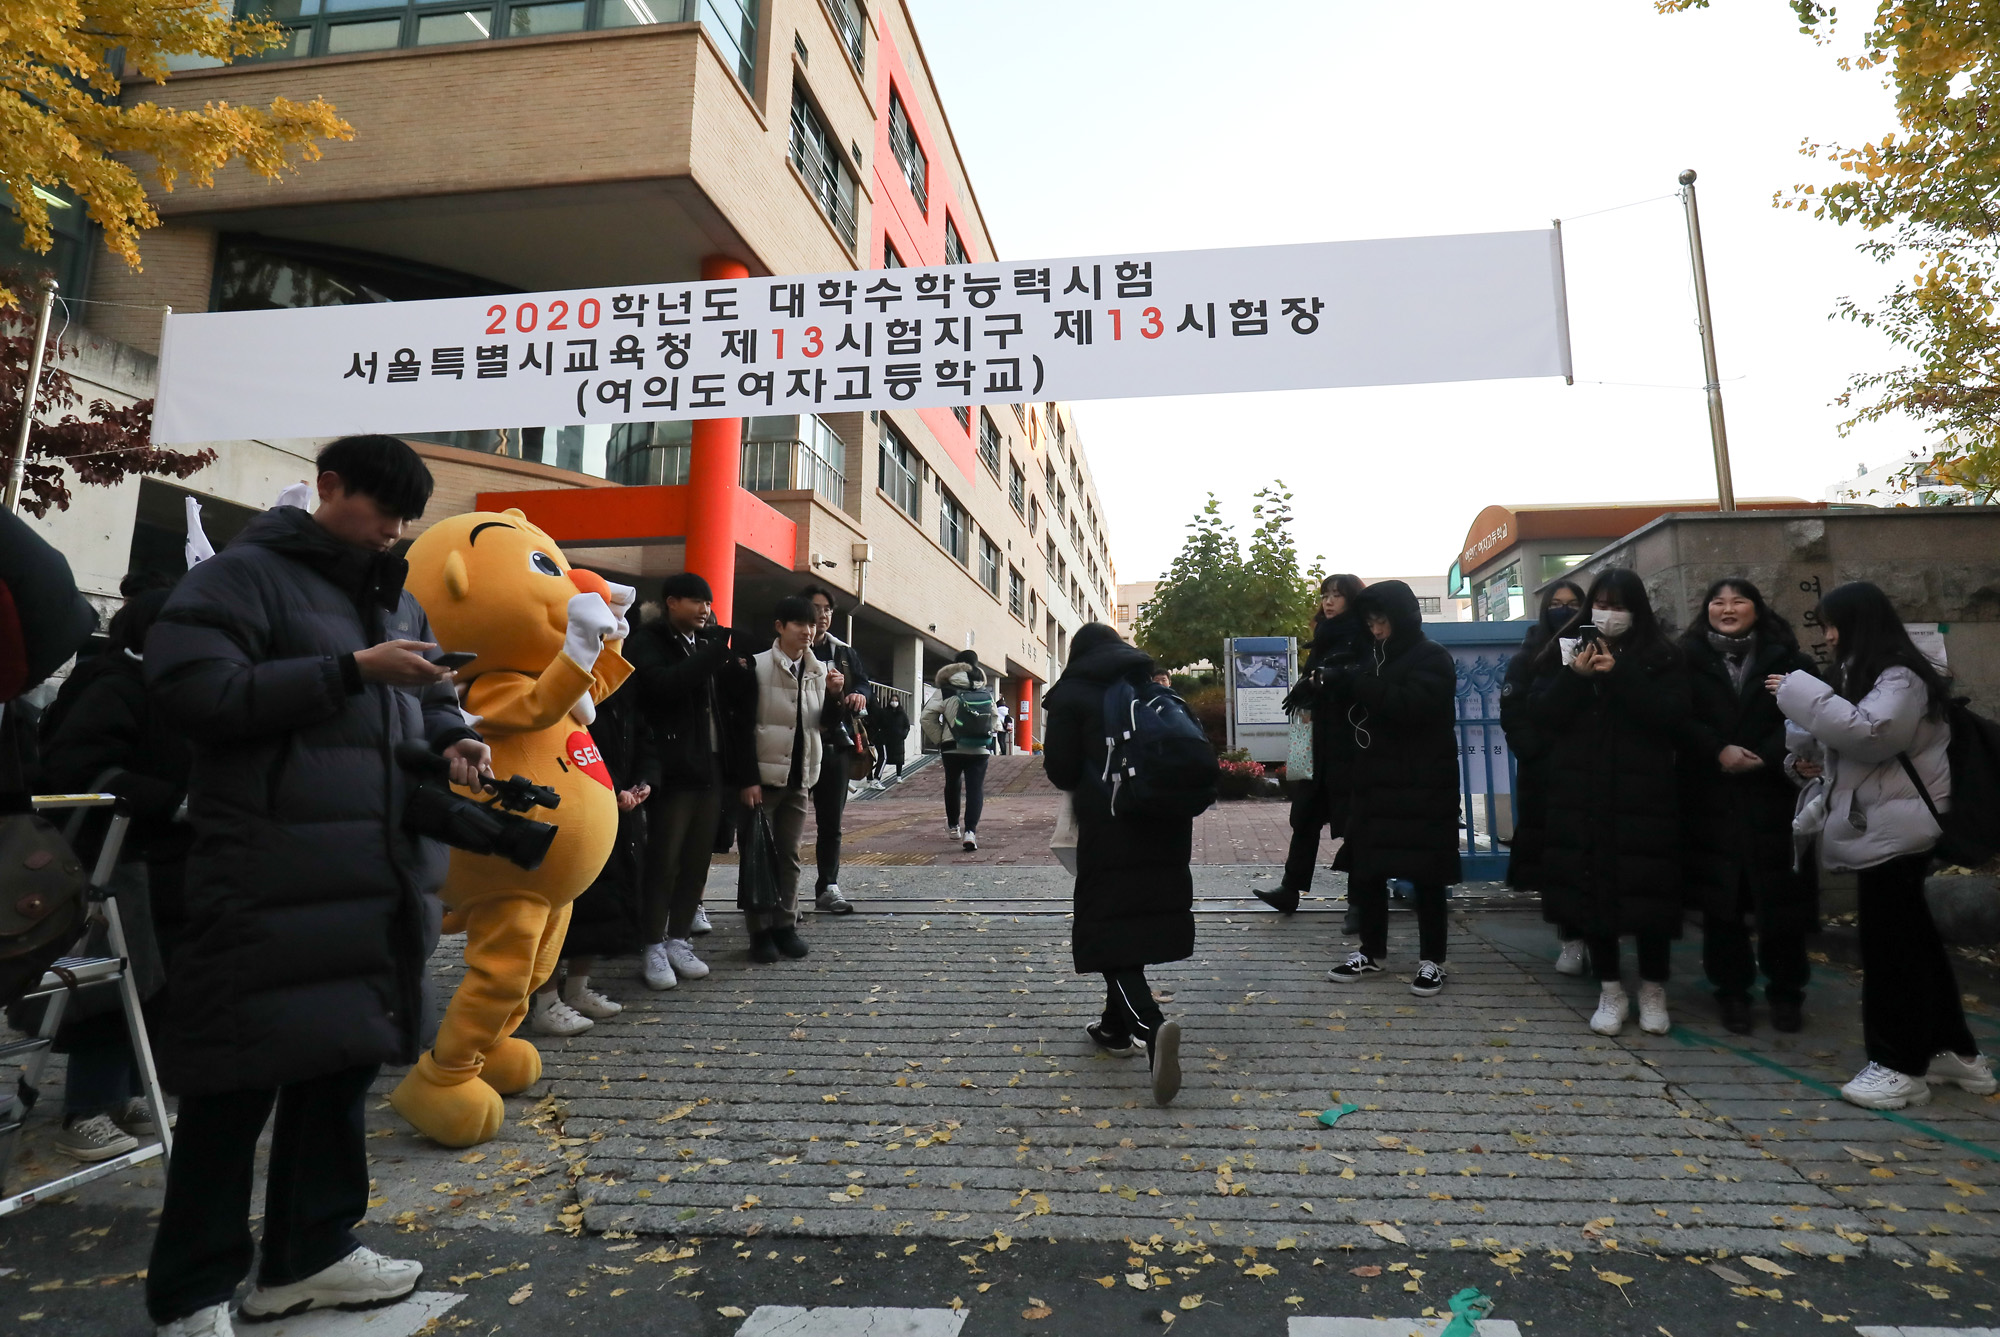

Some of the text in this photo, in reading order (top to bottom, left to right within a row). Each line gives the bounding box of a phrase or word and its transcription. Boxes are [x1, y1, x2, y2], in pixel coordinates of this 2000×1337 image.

[485, 261, 1153, 335] 2020학년도 대학수학능력시험
[343, 297, 1325, 385] 서울특별시교육청 제13시험지구 제13시험장
[577, 353, 1045, 418] (여의도여자고등학교)
